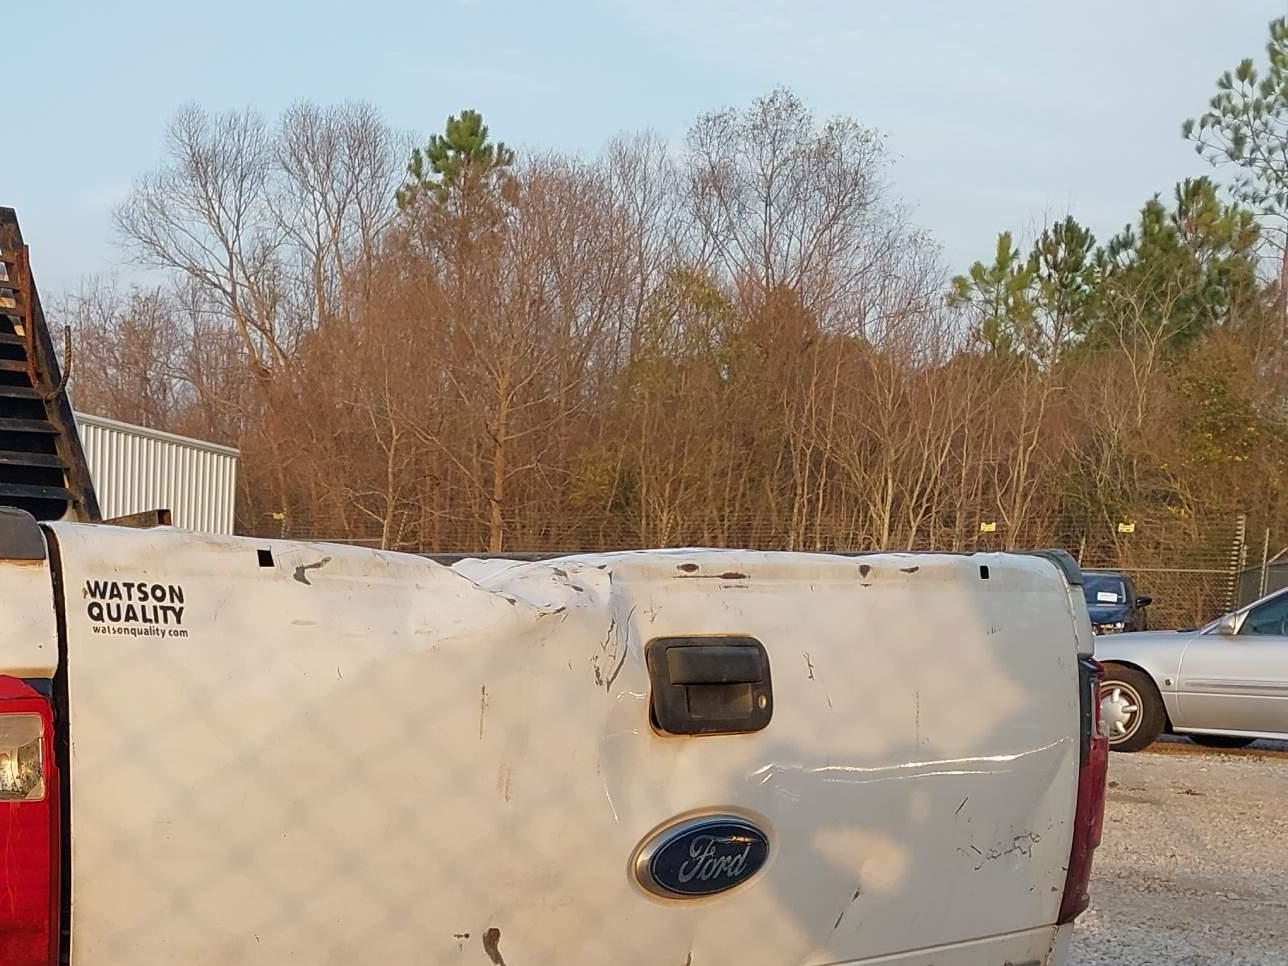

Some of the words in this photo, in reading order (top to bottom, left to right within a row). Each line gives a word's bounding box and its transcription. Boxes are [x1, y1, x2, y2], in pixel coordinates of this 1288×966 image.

[85, 579, 184, 604] WATSON
[87, 602, 185, 625] QUALITY
[678, 834, 754, 884] Ford
